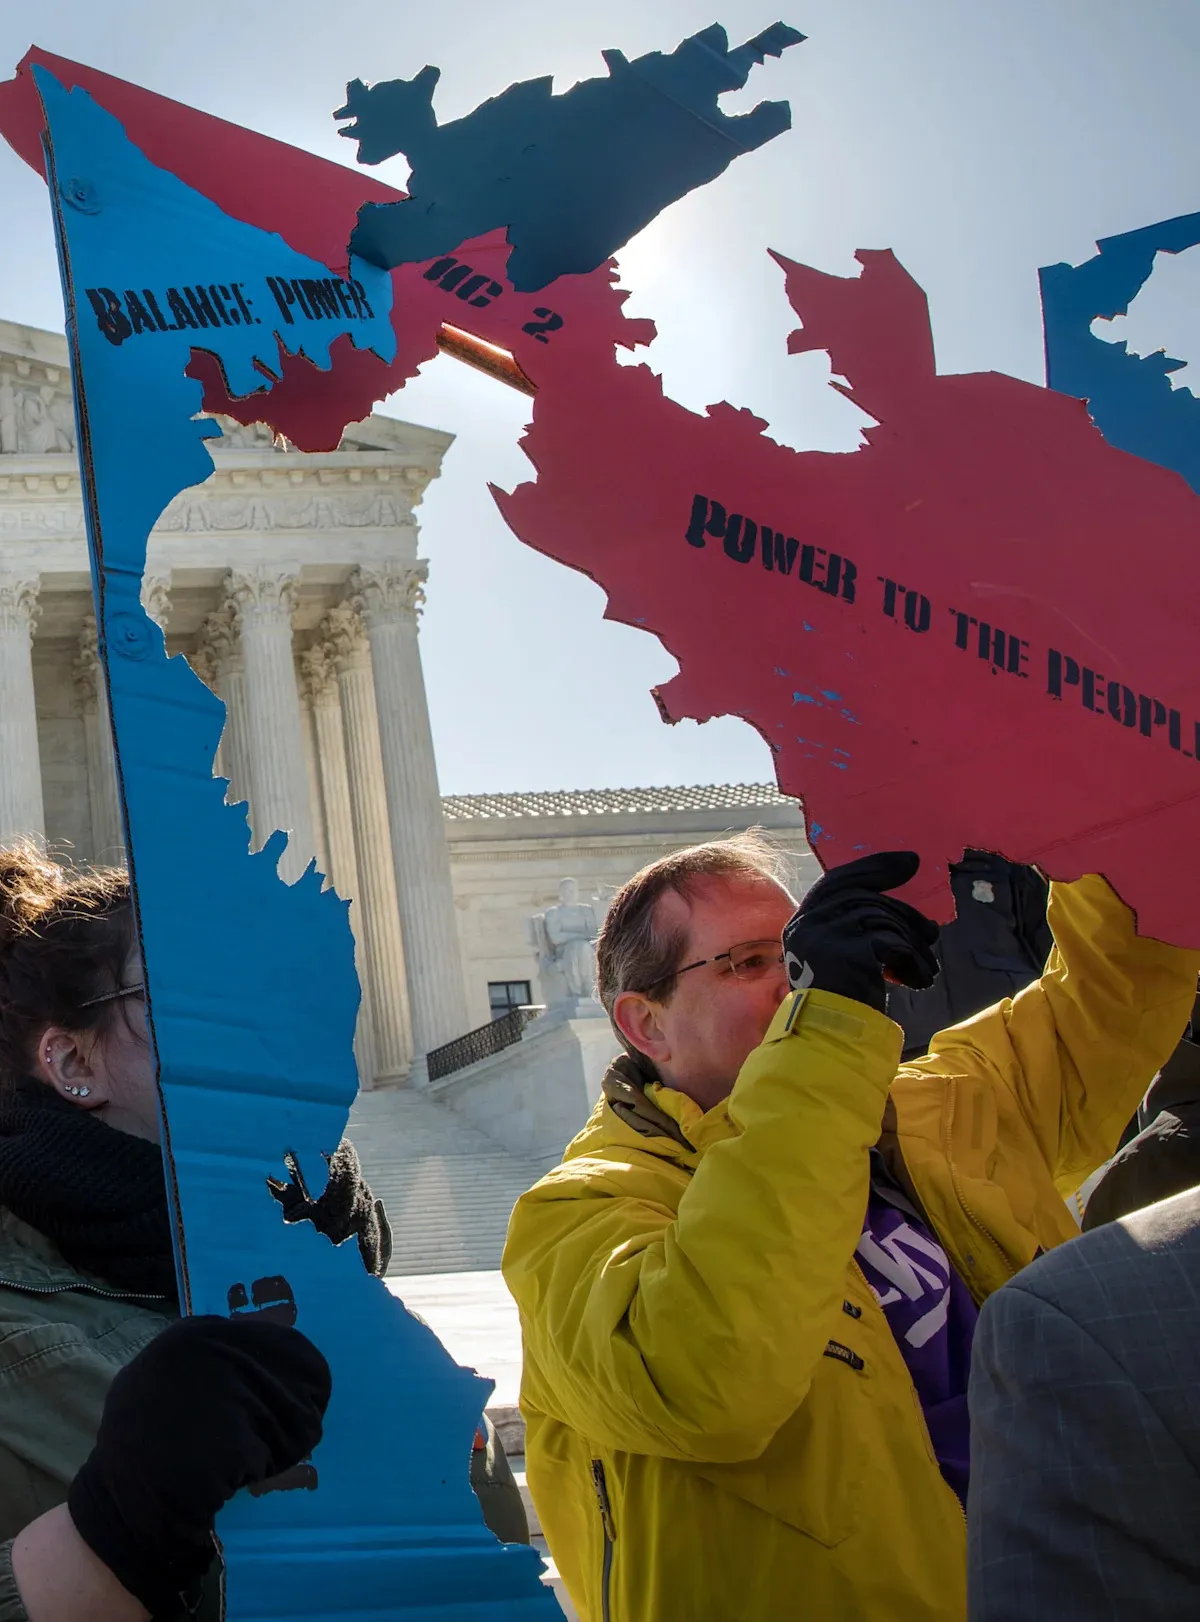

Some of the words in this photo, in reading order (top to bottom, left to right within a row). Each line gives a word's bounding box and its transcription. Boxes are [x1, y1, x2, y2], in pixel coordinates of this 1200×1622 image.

[265, 276, 376, 325] POWER
[521, 307, 564, 344] 2
[685, 494, 857, 604] POWER
[877, 576, 931, 633] TO
[948, 607, 1029, 678] THE
[1047, 647, 1200, 762] PEOPL
